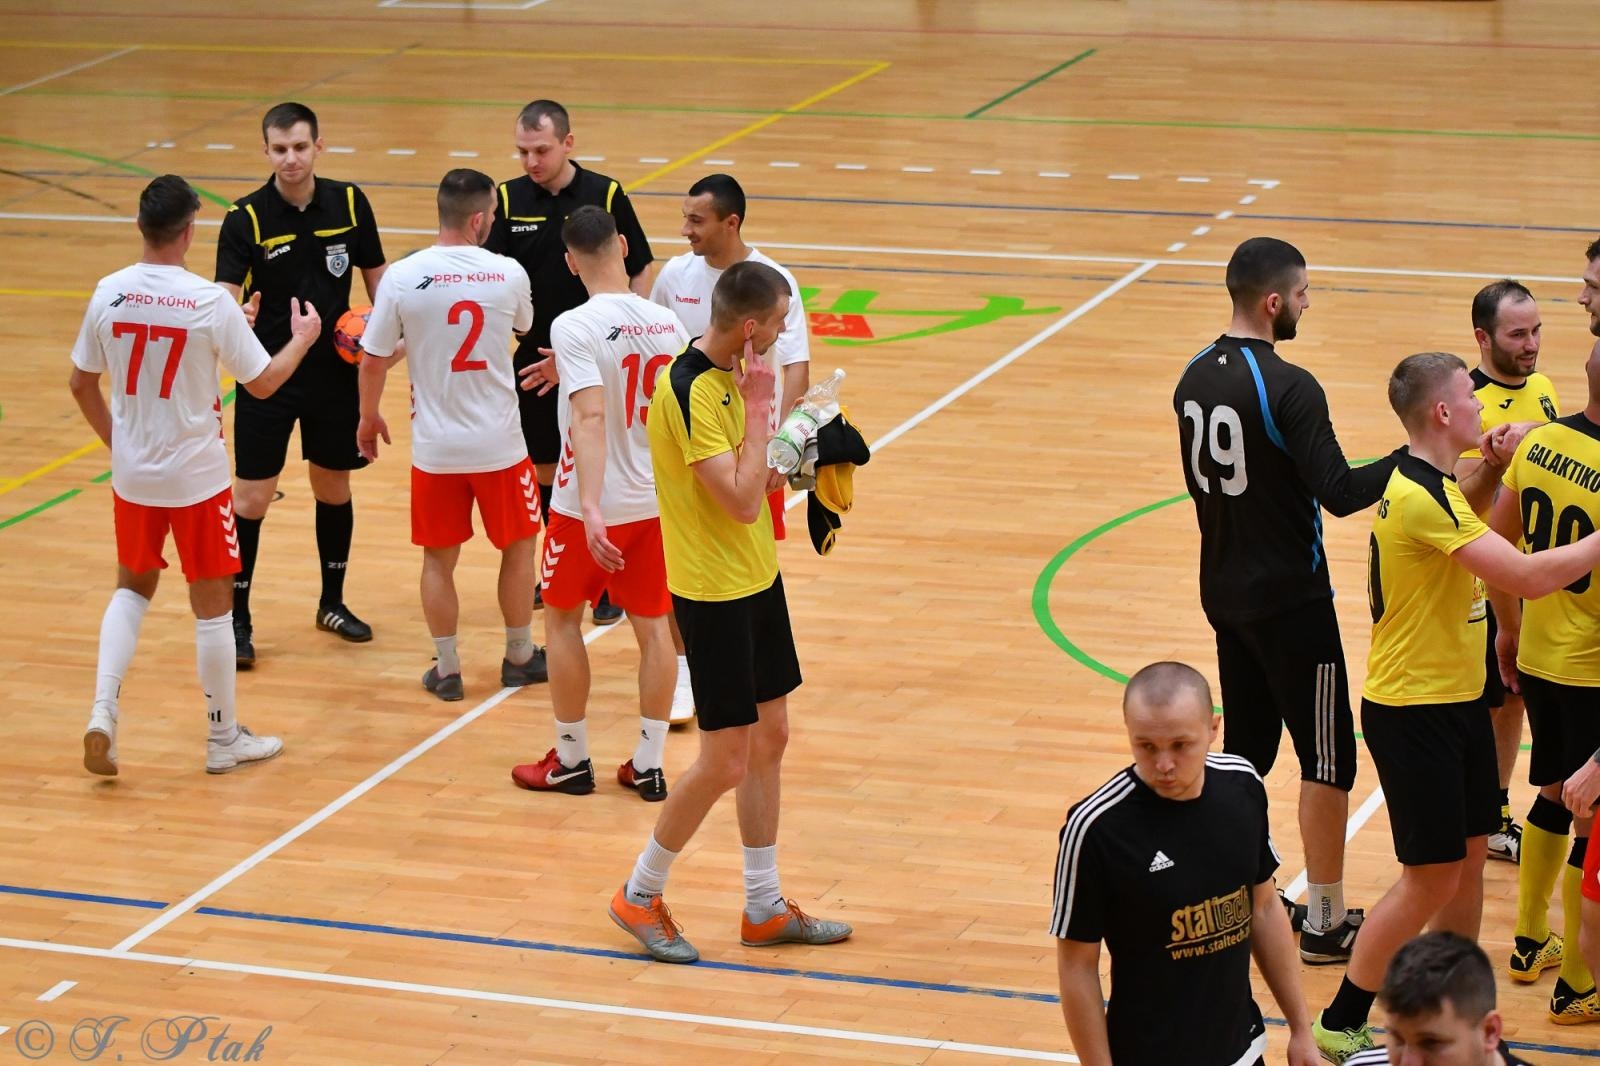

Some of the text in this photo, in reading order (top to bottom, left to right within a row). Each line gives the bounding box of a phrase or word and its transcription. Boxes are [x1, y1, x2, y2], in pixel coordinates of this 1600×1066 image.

[510, 224, 538, 233] zina
[433, 273, 463, 284] PRD
[126, 293, 154, 305] PRD
[675, 294, 701, 305] hummel
[447, 300, 488, 373] 2
[112, 321, 188, 400] 77
[1183, 400, 1248, 497] 29
[1521, 486, 1596, 595] 90
[1148, 859, 1175, 873] adidas
[1171, 884, 1251, 942] staltech
